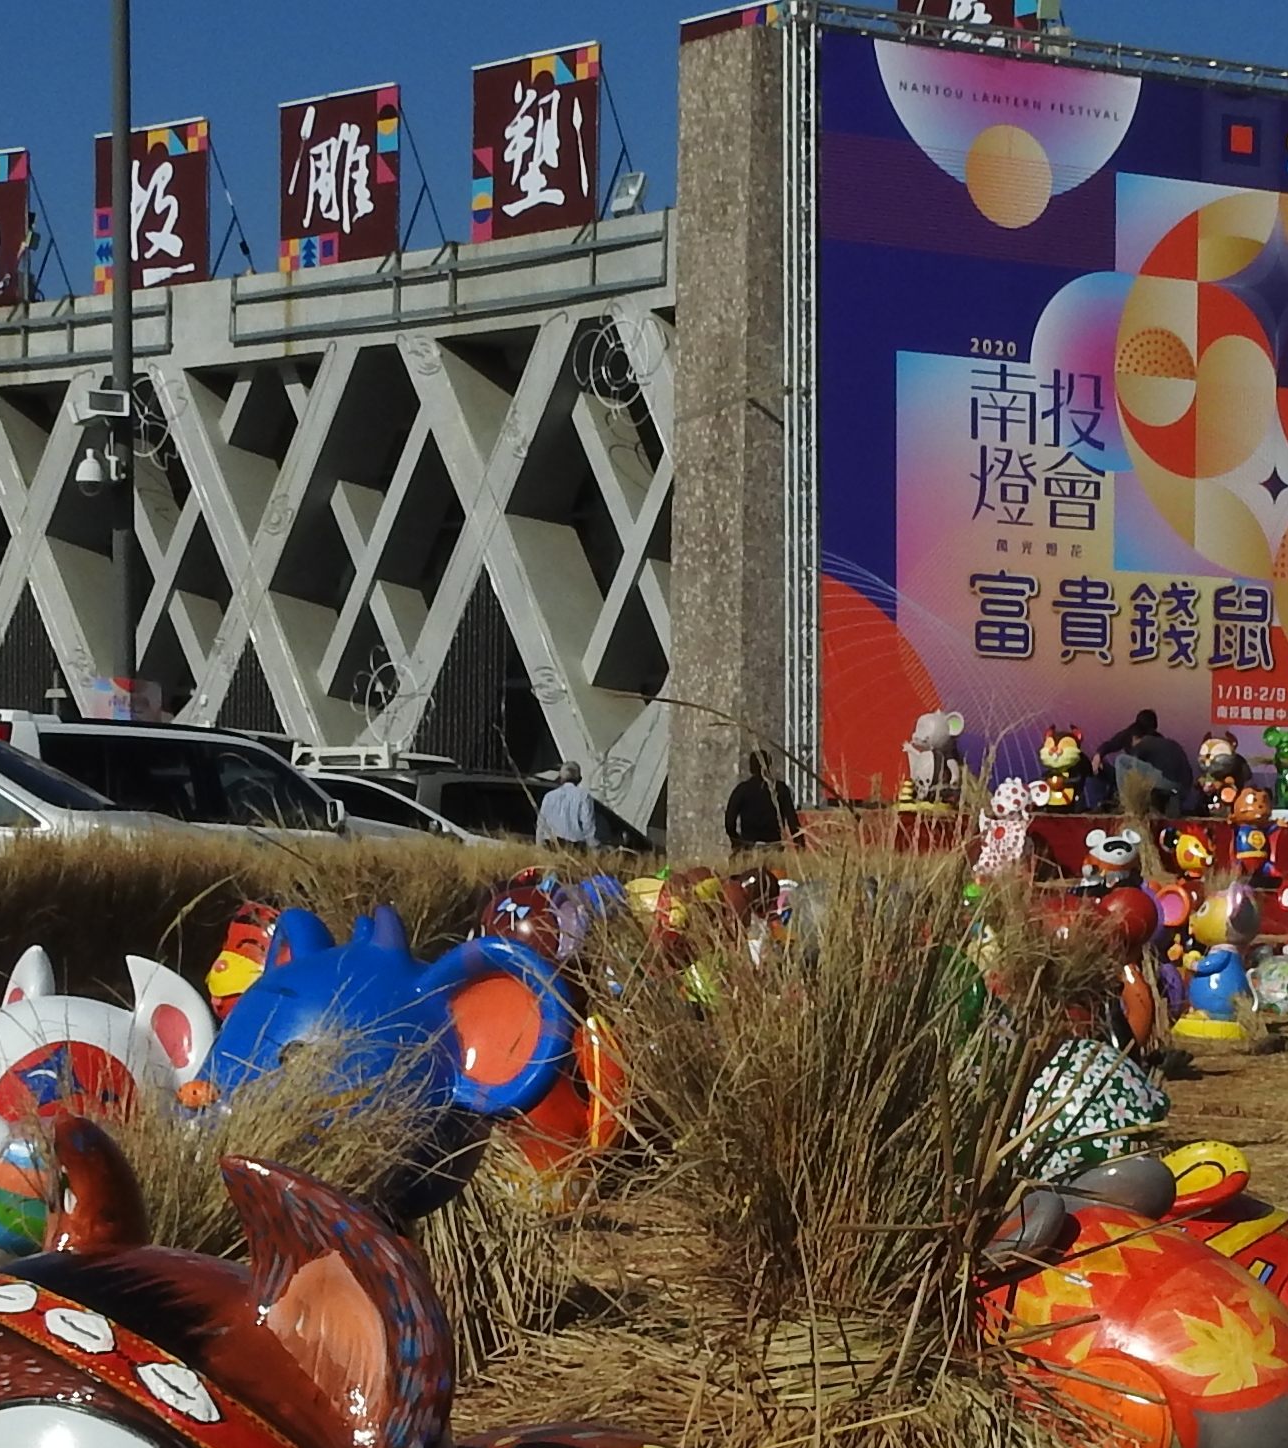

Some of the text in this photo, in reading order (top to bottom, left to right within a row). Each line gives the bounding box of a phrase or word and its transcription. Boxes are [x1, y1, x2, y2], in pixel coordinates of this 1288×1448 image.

[899, 79, 1121, 122] NANTOU LANTERN FESTIVAL
[970, 337, 1017, 357] 2020
[970, 363, 1106, 451] 南投
[969, 445, 1106, 531] 燈會
[969, 568, 1275, 671] 富貴錢鼠
